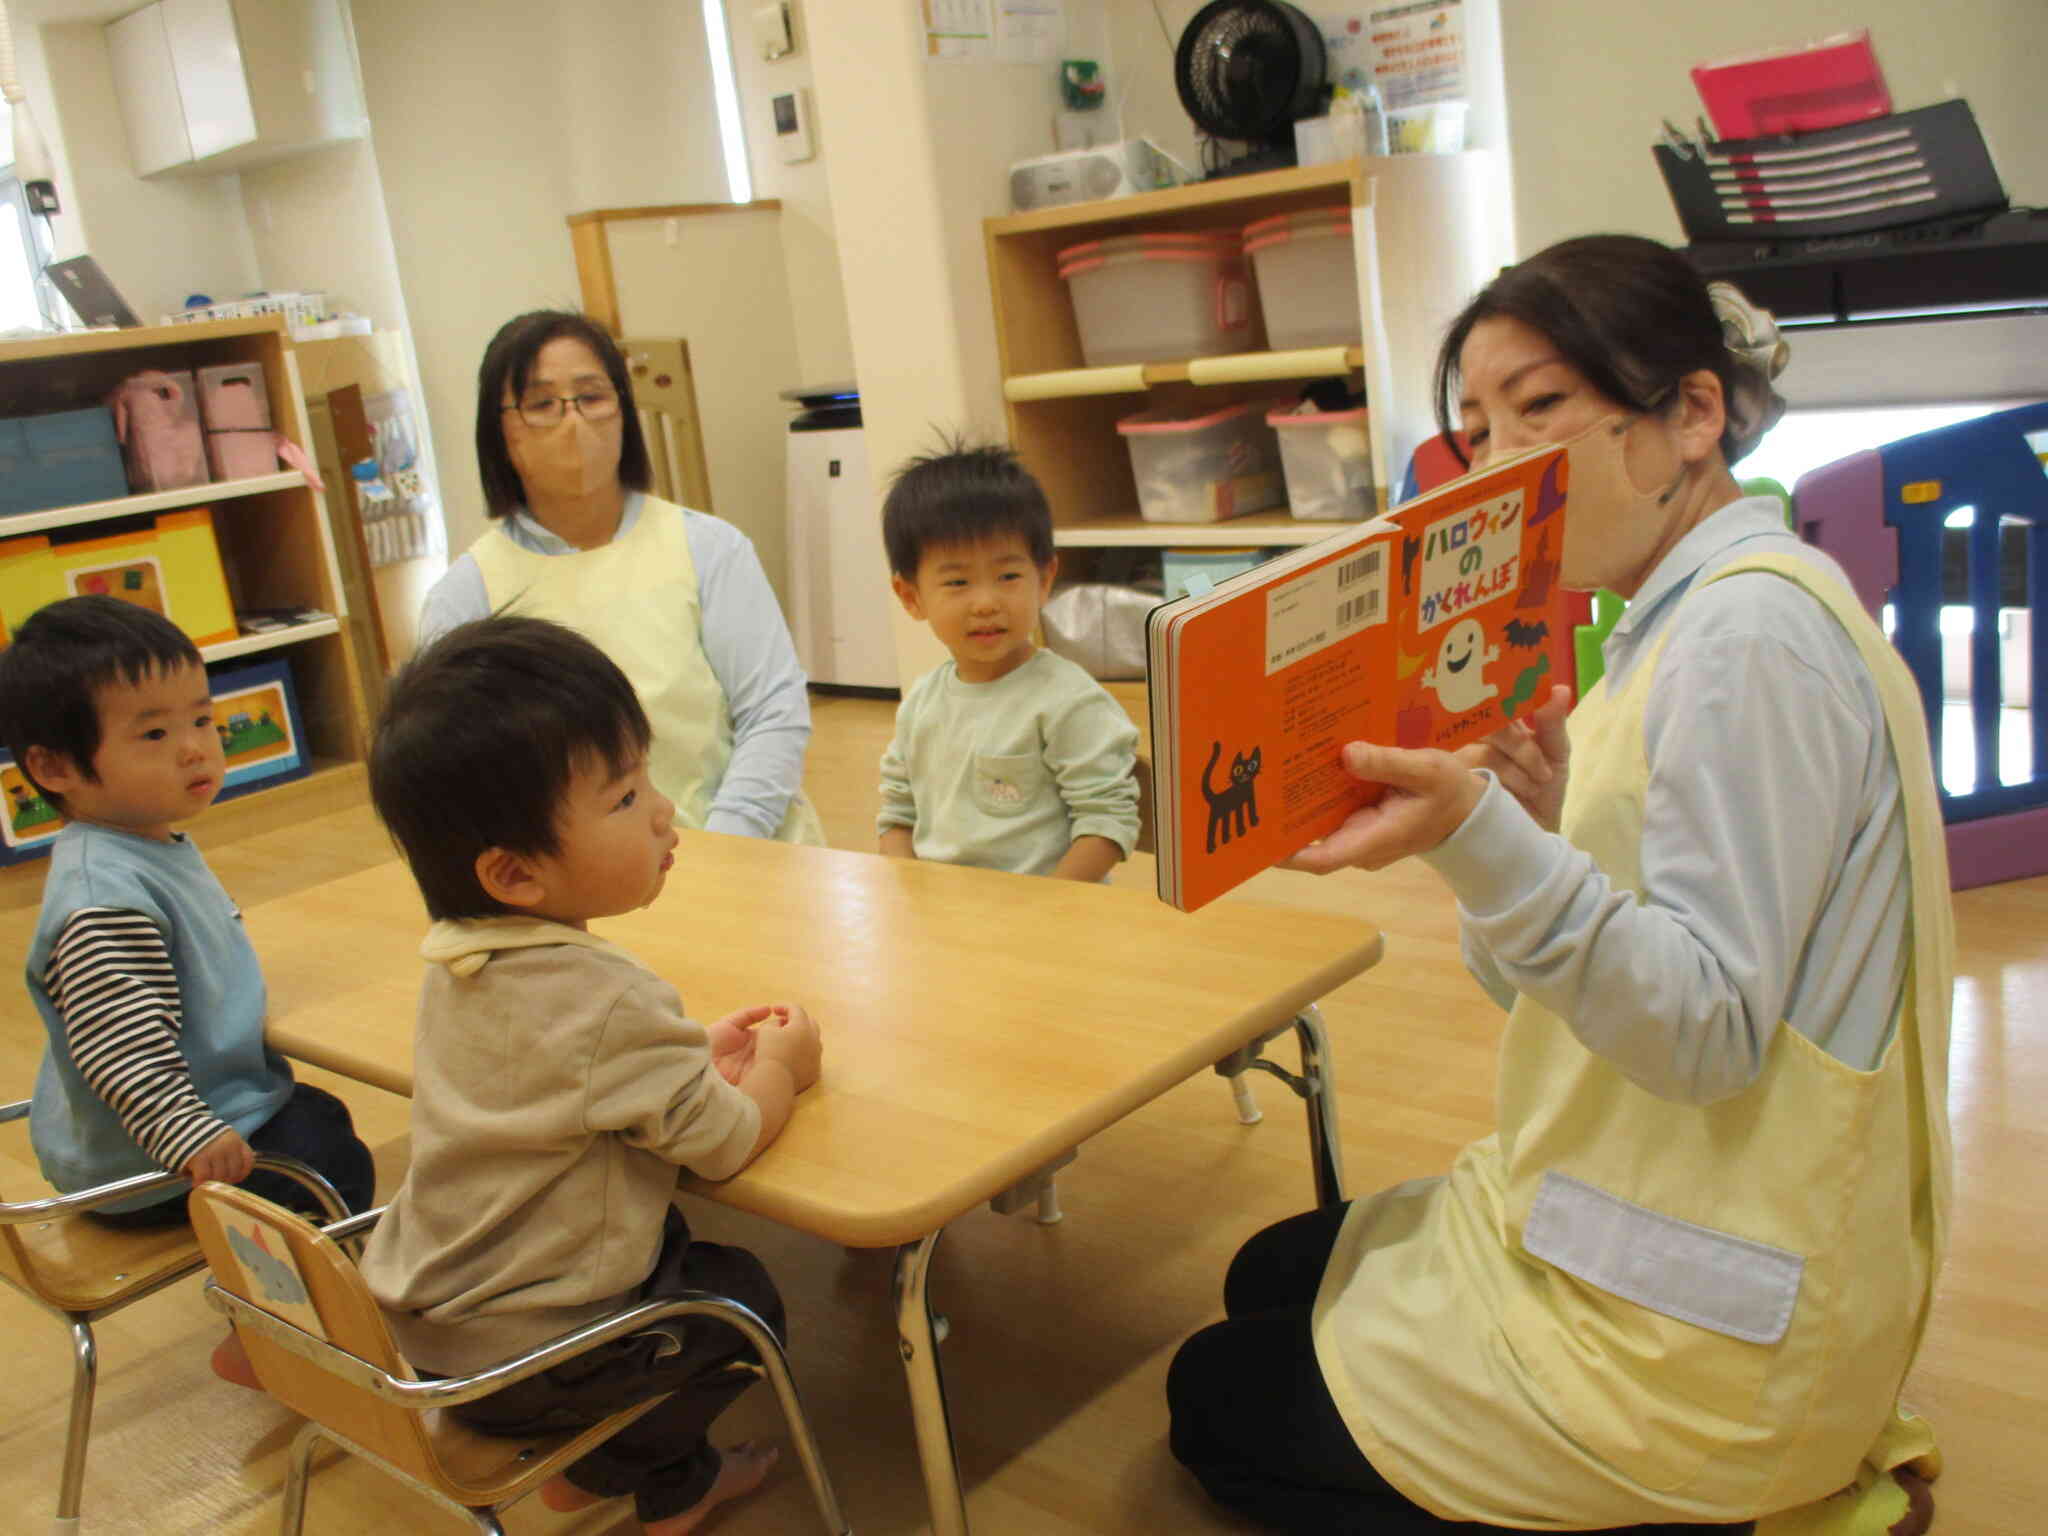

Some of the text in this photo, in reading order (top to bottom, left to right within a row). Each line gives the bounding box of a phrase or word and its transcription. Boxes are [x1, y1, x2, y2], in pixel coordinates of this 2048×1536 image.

[1425, 502, 1521, 562] ハロウィン
[1459, 545, 1483, 576] の
[1422, 554, 1519, 623] かくれんぼ
